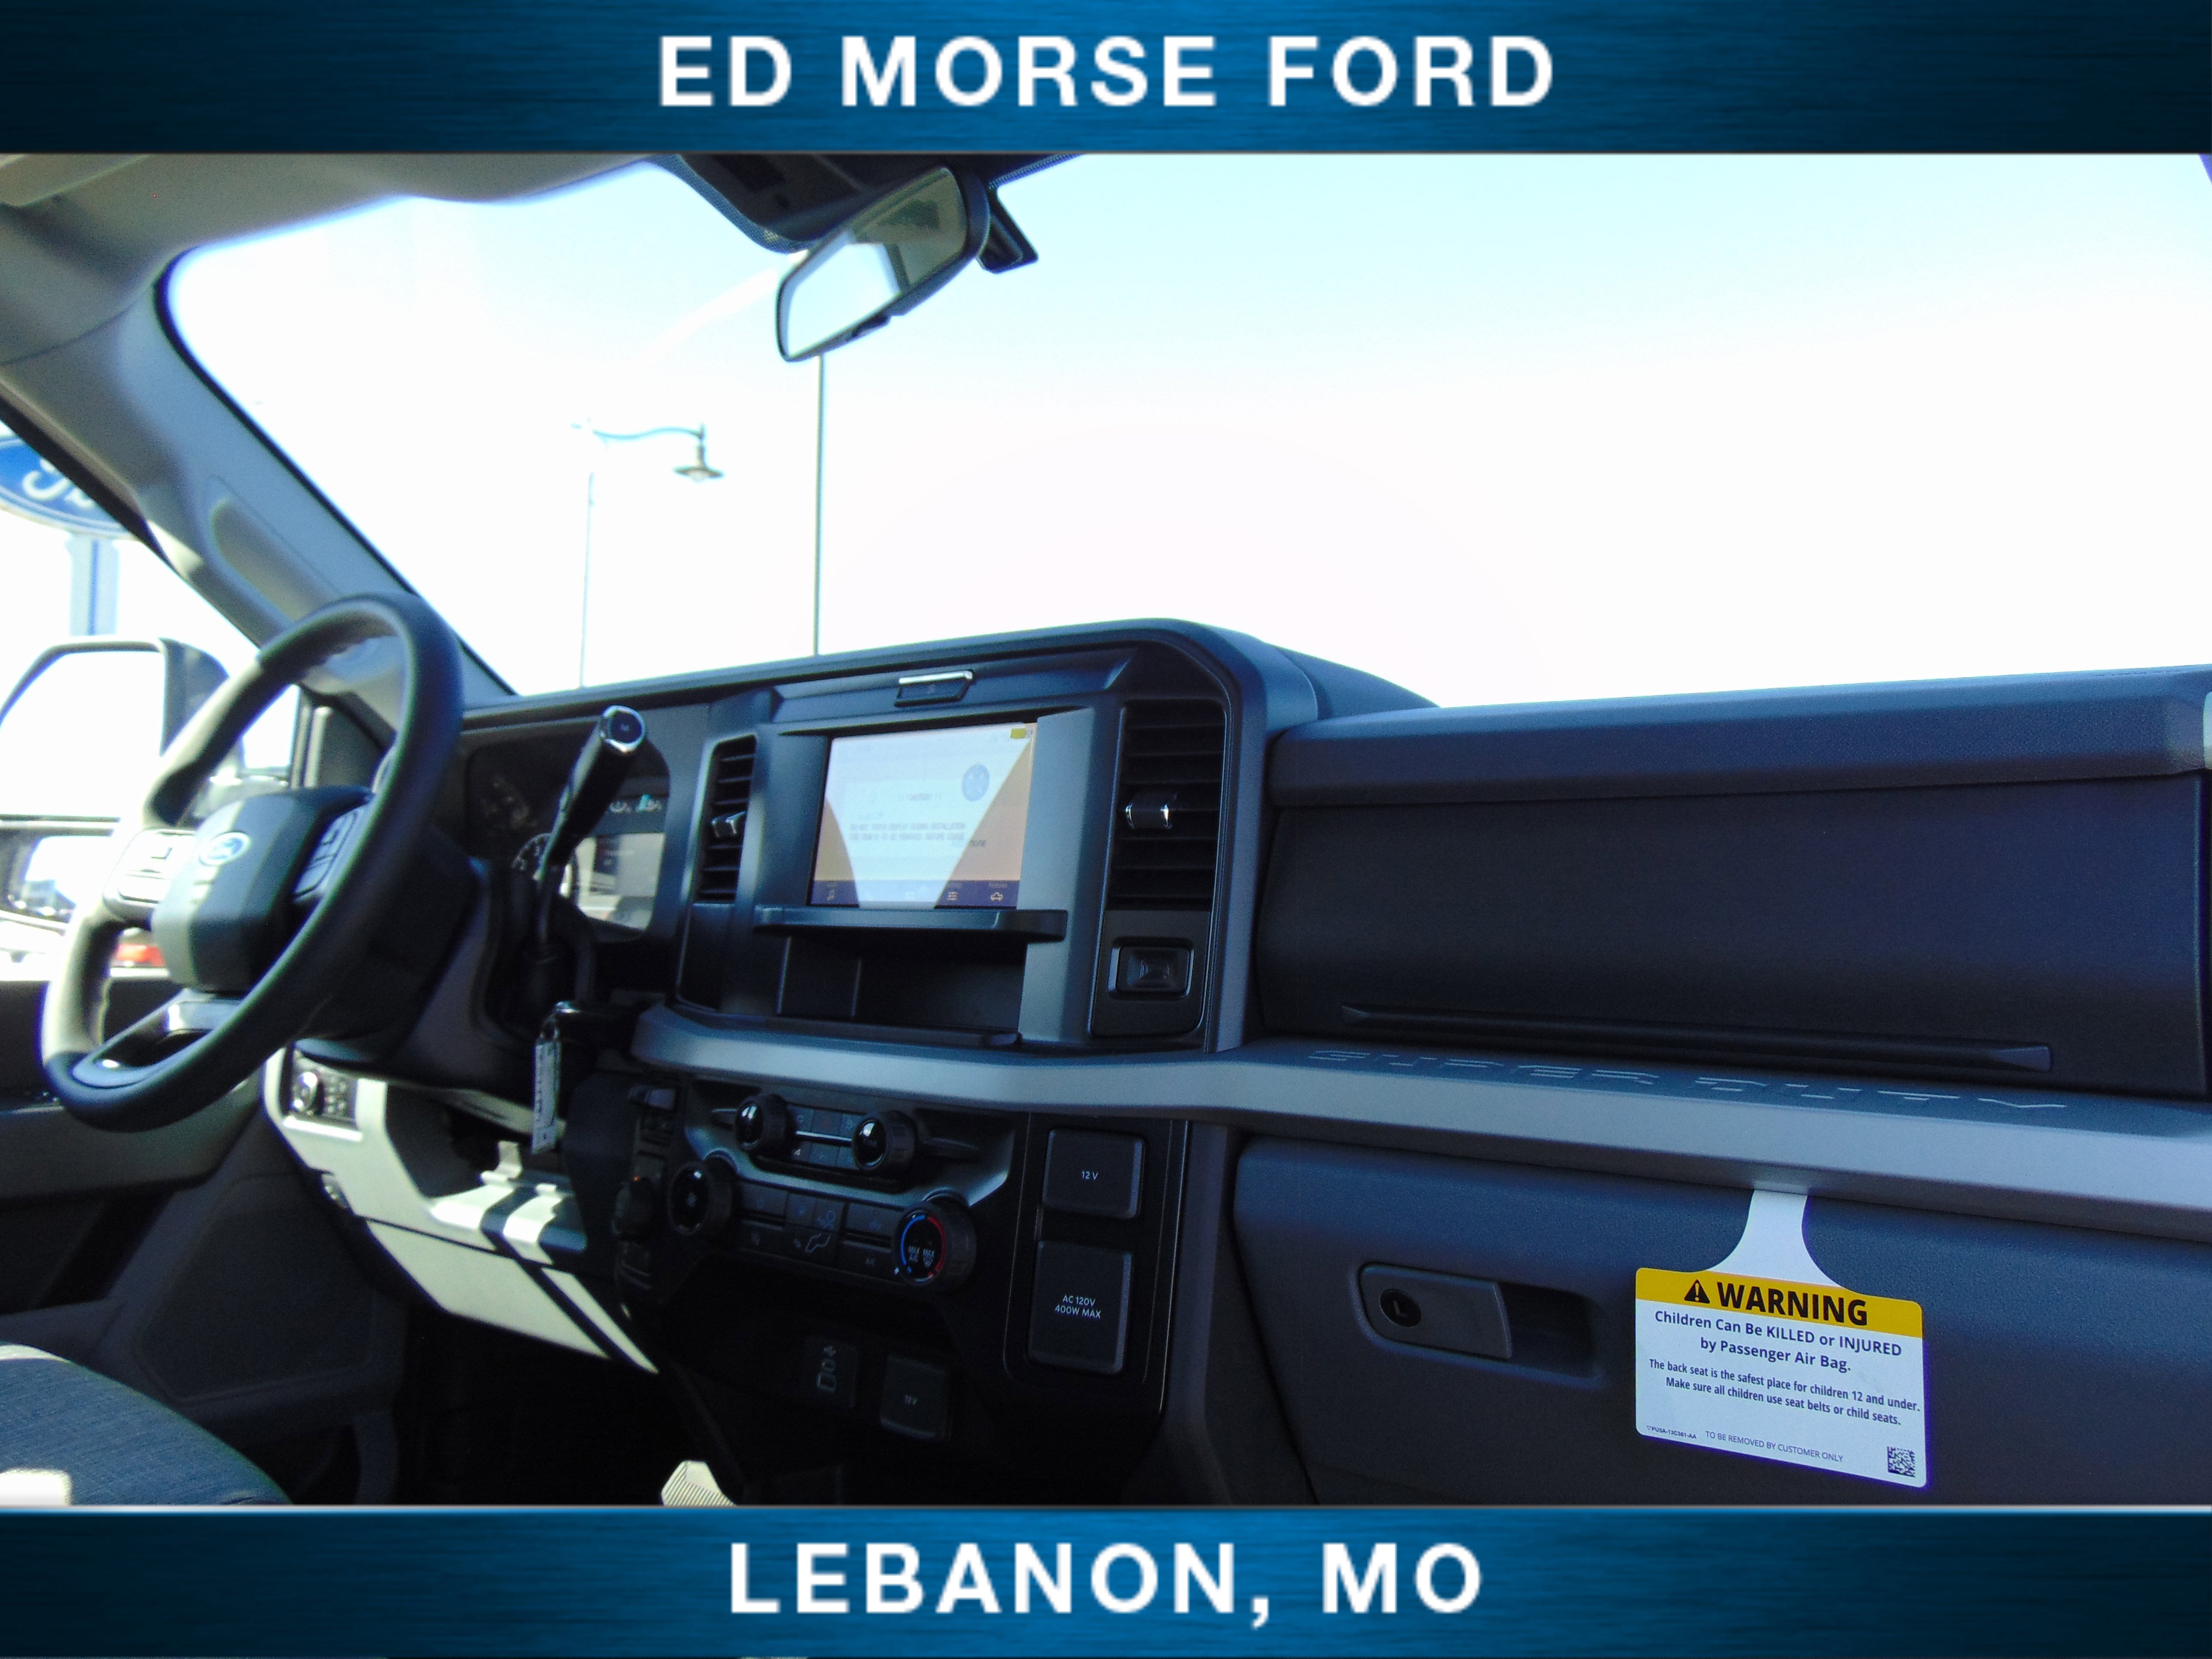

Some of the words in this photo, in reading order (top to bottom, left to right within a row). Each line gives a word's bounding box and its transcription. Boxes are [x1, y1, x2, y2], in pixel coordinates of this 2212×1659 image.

[1082, 1171, 1090, 1179] 12
[1092, 1172, 1098, 1180] V
[1055, 1304, 1080, 1316] 400W
[1082, 1308, 1101, 1319] MAX
[1062, 1294, 1074, 1304] AC
[1076, 1296, 1096, 1307] 120V
[1717, 1281, 1868, 1326] WARNING
[1655, 1310, 1711, 1329] Children
[1716, 1319, 1741, 1333] Can
[1745, 1322, 1762, 1336] Be
[1766, 1325, 1815, 1343] KILLED
[1819, 1335, 1835, 1346] or
[1839, 1335, 1902, 1356] INJURED
[1700, 1336, 1717, 1353] by
[1720, 1340, 1791, 1363] Passenger
[1794, 1351, 1816, 1365] Air
[1820, 1355, 1851, 1373] Bag.
[1649, 1358, 1665, 1370] The
[1667, 1361, 1687, 1373] back
[1689, 1366, 1708, 1376] seat
[1711, 1367, 1718, 1378] is
[1720, 1369, 1735, 1381] the
[1737, 1373, 1764, 1386] safest
[1766, 1376, 1791, 1390] place
[1793, 1380, 1808, 1392] for
[1810, 1384, 1849, 1400] children
[1851, 1391, 1863, 1401] 12
[1866, 1395, 1884, 1405] and
[1887, 1398, 1920, 1412] under.
[1666, 1376, 1690, 1389] Make
[1692, 1382, 1712, 1393] sure
[1714, 1385, 1725, 1395] all
[1727, 1387, 1764, 1402] children
[1766, 1394, 1782, 1405] use
[1785, 1397, 1805, 1409] seat
[1807, 1399, 1831, 1413] belts
[1833, 1405, 1844, 1415] or
[1846, 1406, 1870, 1419] child
[1872, 1412, 1901, 1425] seats.
[1705, 1430, 1716, 1439] TO
[1717, 1433, 1726, 1441] BE
[1728, 1434, 1764, 1448] REMOVED
[1766, 1441, 1776, 1450] BY
[1778, 1444, 1820, 1458] CUSTOMER
[1821, 1452, 1844, 1462] ONLY
